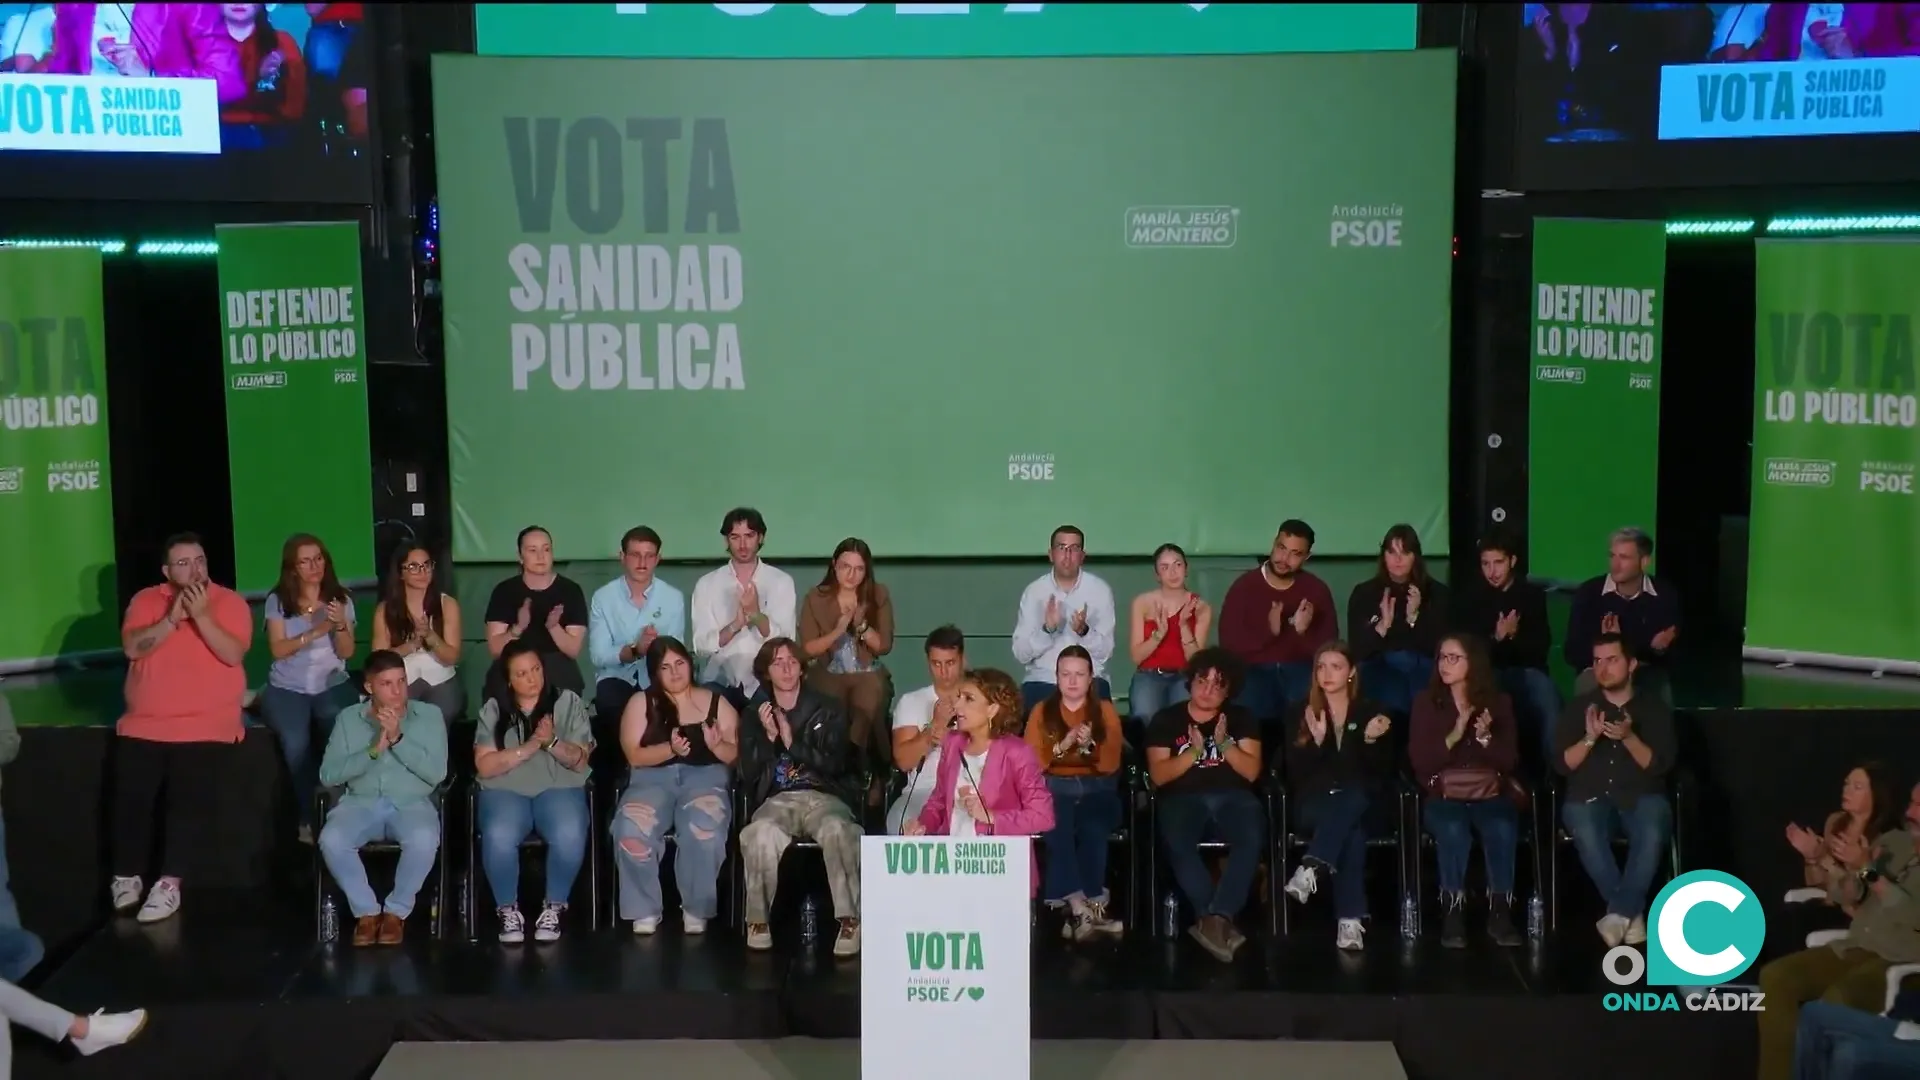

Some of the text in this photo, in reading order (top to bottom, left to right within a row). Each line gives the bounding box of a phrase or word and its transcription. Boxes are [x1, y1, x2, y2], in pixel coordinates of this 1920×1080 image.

[1697, 71, 1795, 123] VOTA
[1804, 68, 1886, 93] SANIDAD
[101, 86, 181, 111] SANIDAD
[503, 116, 741, 234] VOTA
[1132, 208, 1230, 226] MARÍA JESÚS
[1332, 203, 1403, 217] Andalucía
[1132, 226, 1230, 243] MONTERO
[1330, 220, 1402, 247] PSOE
[508, 243, 743, 312] SANIDAD
[226, 287, 354, 328] DEFIENDE
[1537, 283, 1655, 326] DEFIENDE
[230, 327, 356, 364] LO PÚBLICO
[511, 312, 745, 391] PÚBLICA
[1537, 325, 1654, 363] LO PÚBLICO
[1768, 311, 1916, 390] VOTA
[0, 393, 98, 430] ÚBLICO
[1765, 387, 1916, 427] LO PÚBLICO
[48, 470, 100, 493] PSOE
[1009, 463, 1054, 480] PSOE
[1860, 471, 1914, 494] PSOE
[885, 843, 950, 875] VOTA
[955, 843, 1006, 858] SANIDAD
[906, 932, 984, 970] VOTA
[907, 986, 950, 1002] PSOE
